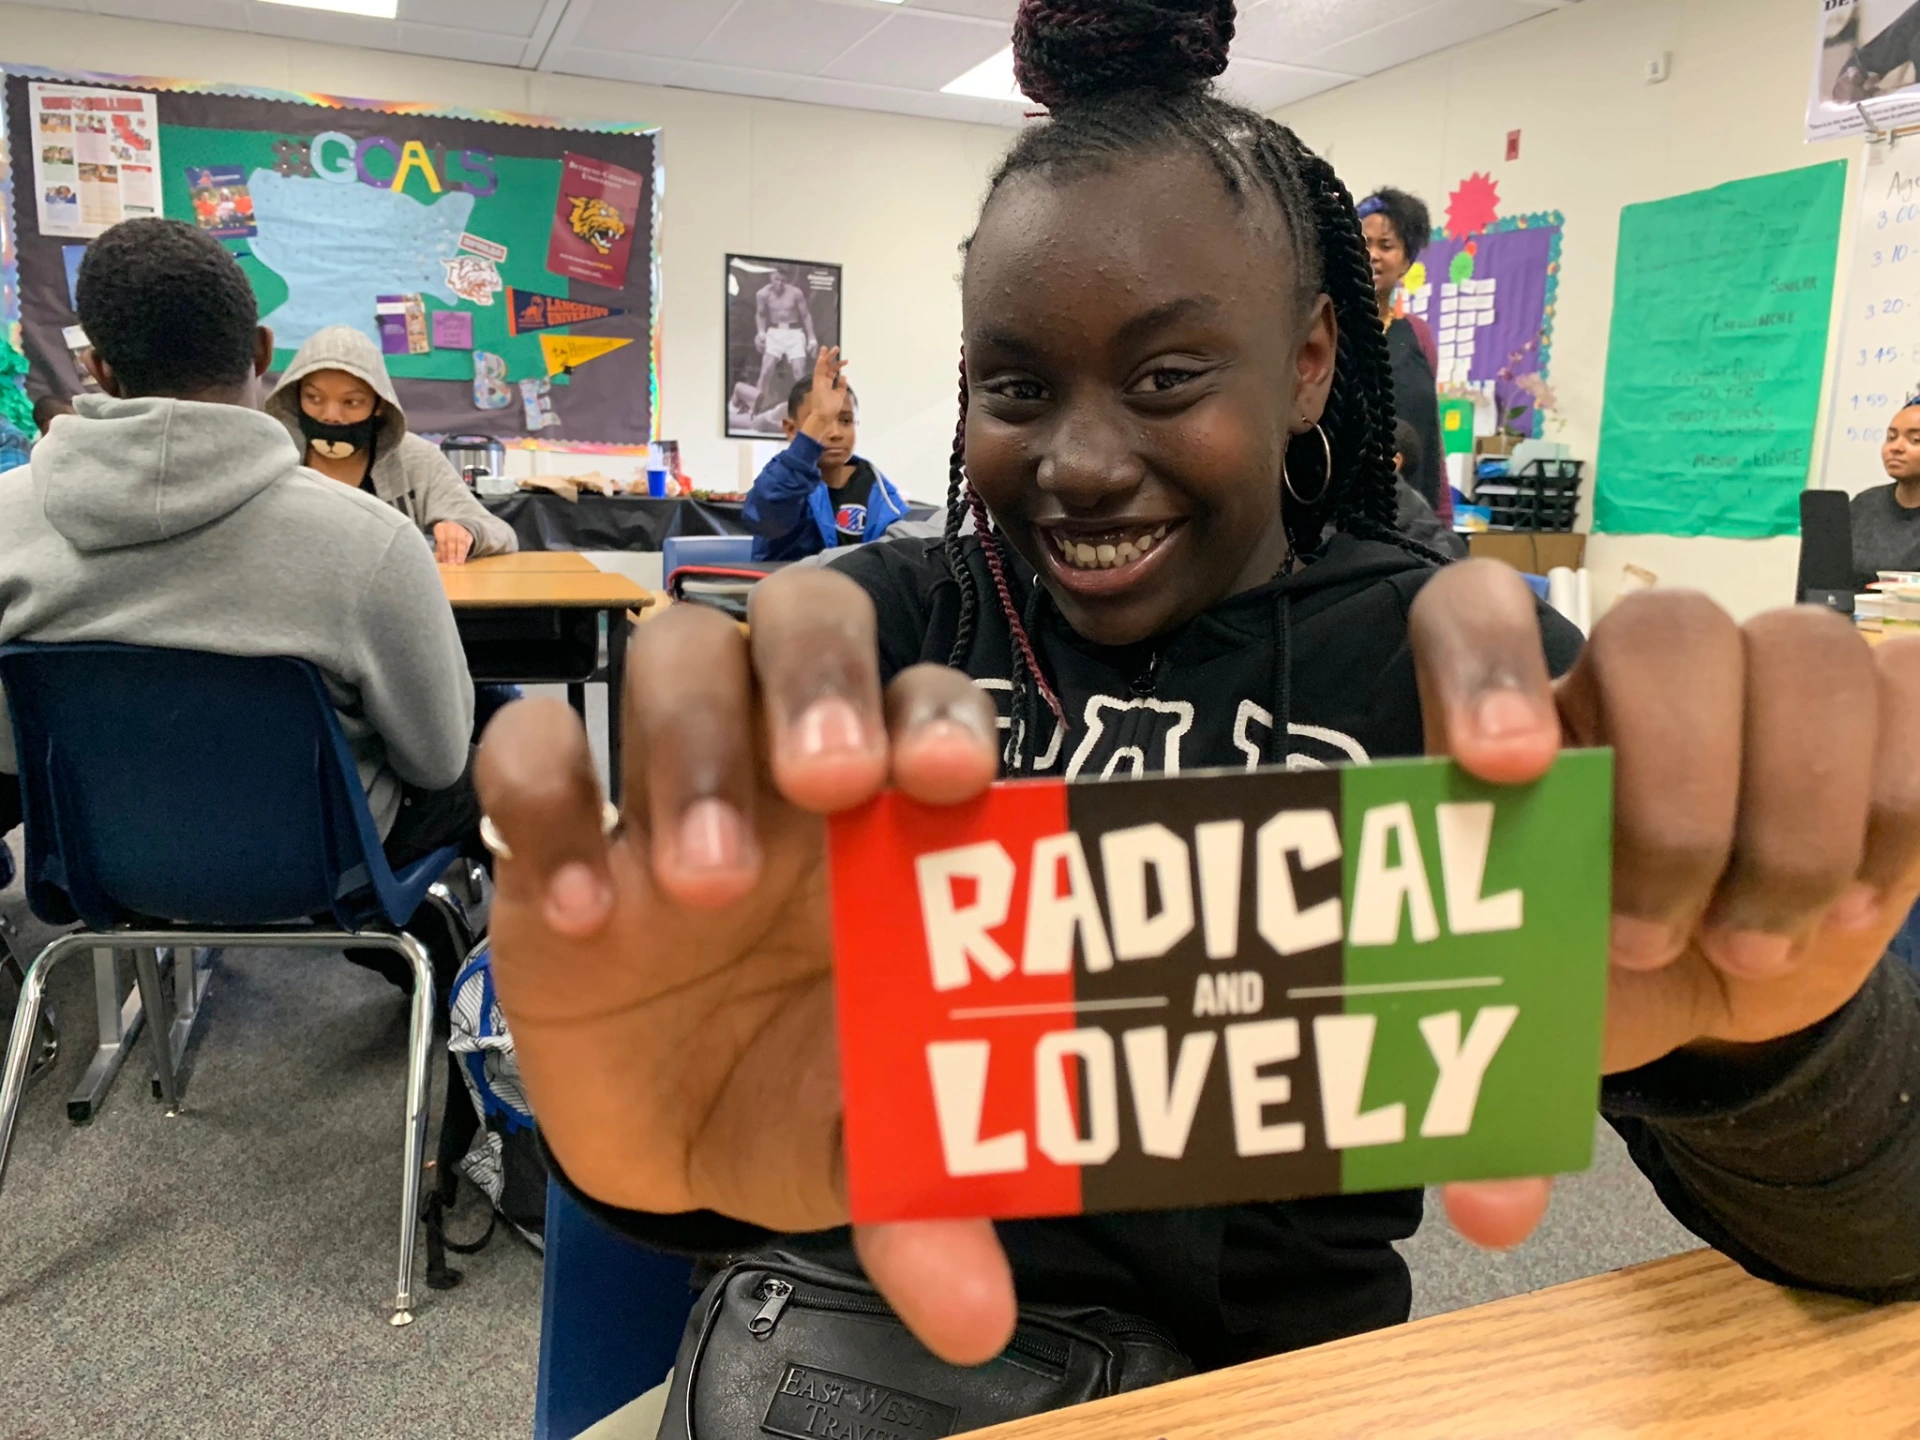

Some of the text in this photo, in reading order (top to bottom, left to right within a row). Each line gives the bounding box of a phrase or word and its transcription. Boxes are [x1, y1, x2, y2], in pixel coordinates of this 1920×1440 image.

[914, 801, 1523, 991] RADICAL
[1193, 971, 1264, 1017] AND
[926, 1006, 1520, 1177] LOVELY
[805, 1403, 902, 1440] TRAVE
[859, 1384, 933, 1430] WEST
